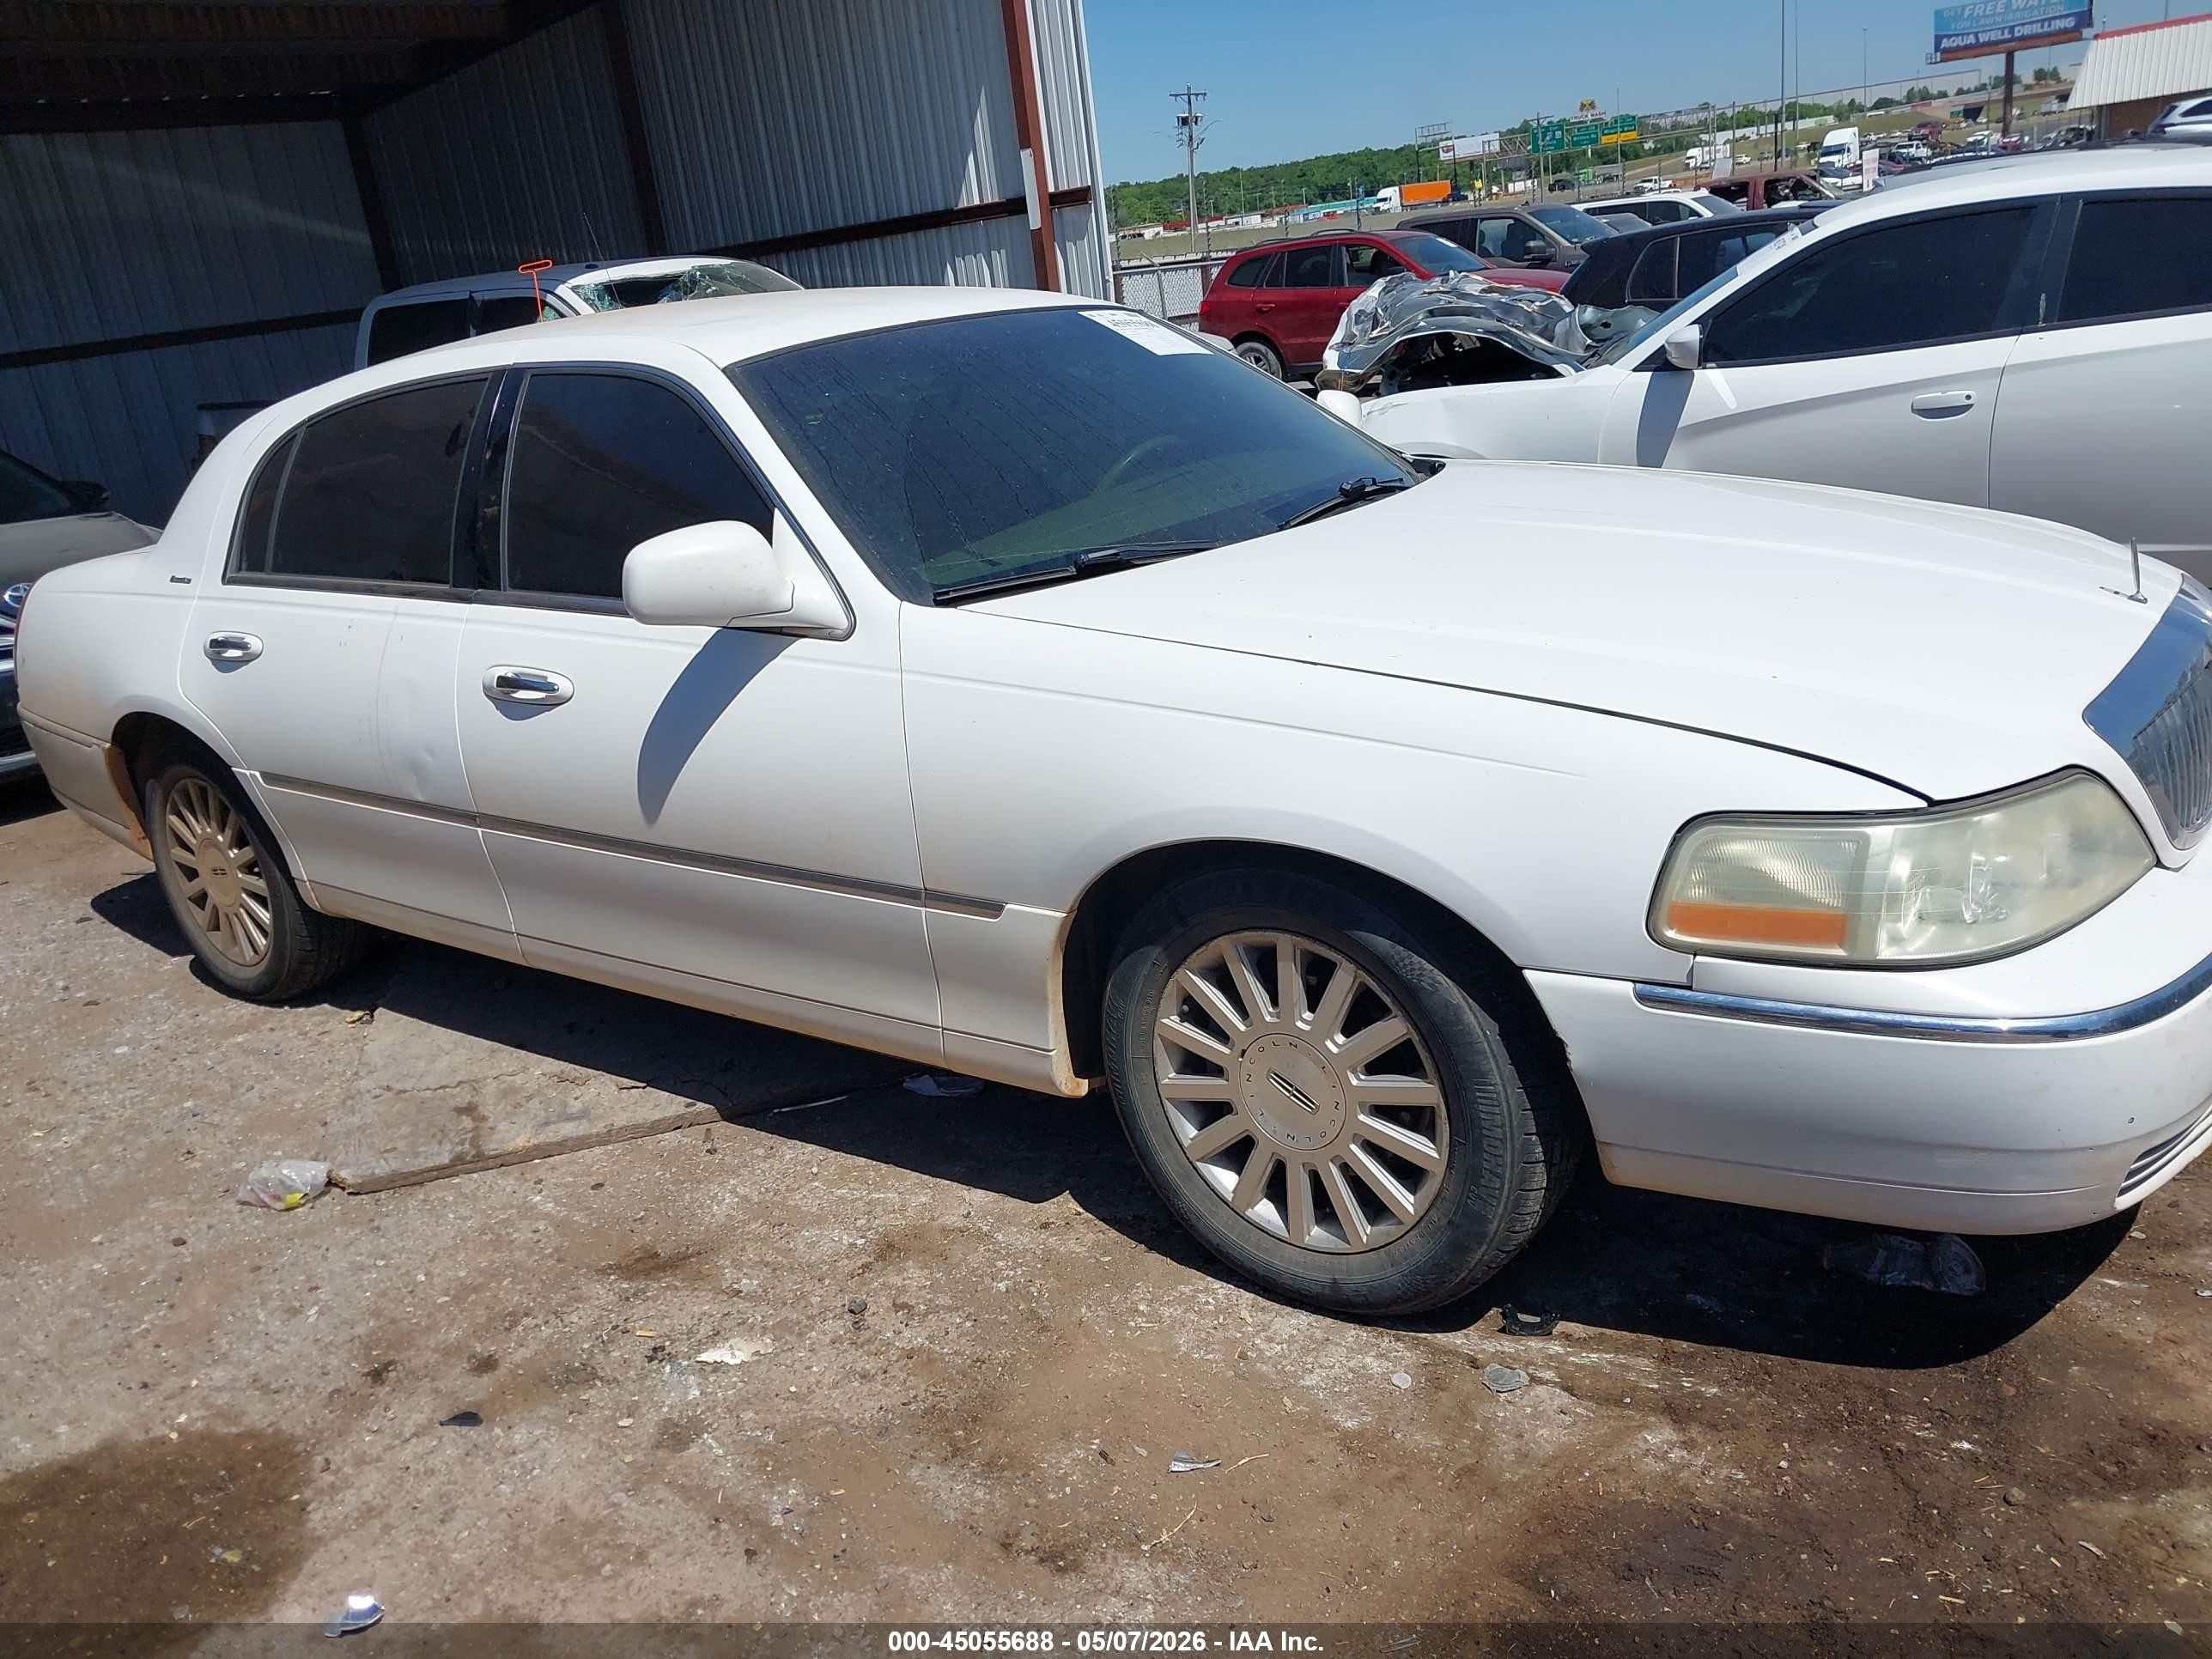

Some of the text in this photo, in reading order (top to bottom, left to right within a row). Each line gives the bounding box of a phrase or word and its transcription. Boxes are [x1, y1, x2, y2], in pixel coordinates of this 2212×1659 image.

[1963, 0, 2007, 19] FREE
[2004, 3, 2064, 22] IRRIGATION
[1940, 16, 2075, 49] AQUA WELL DRILLING
